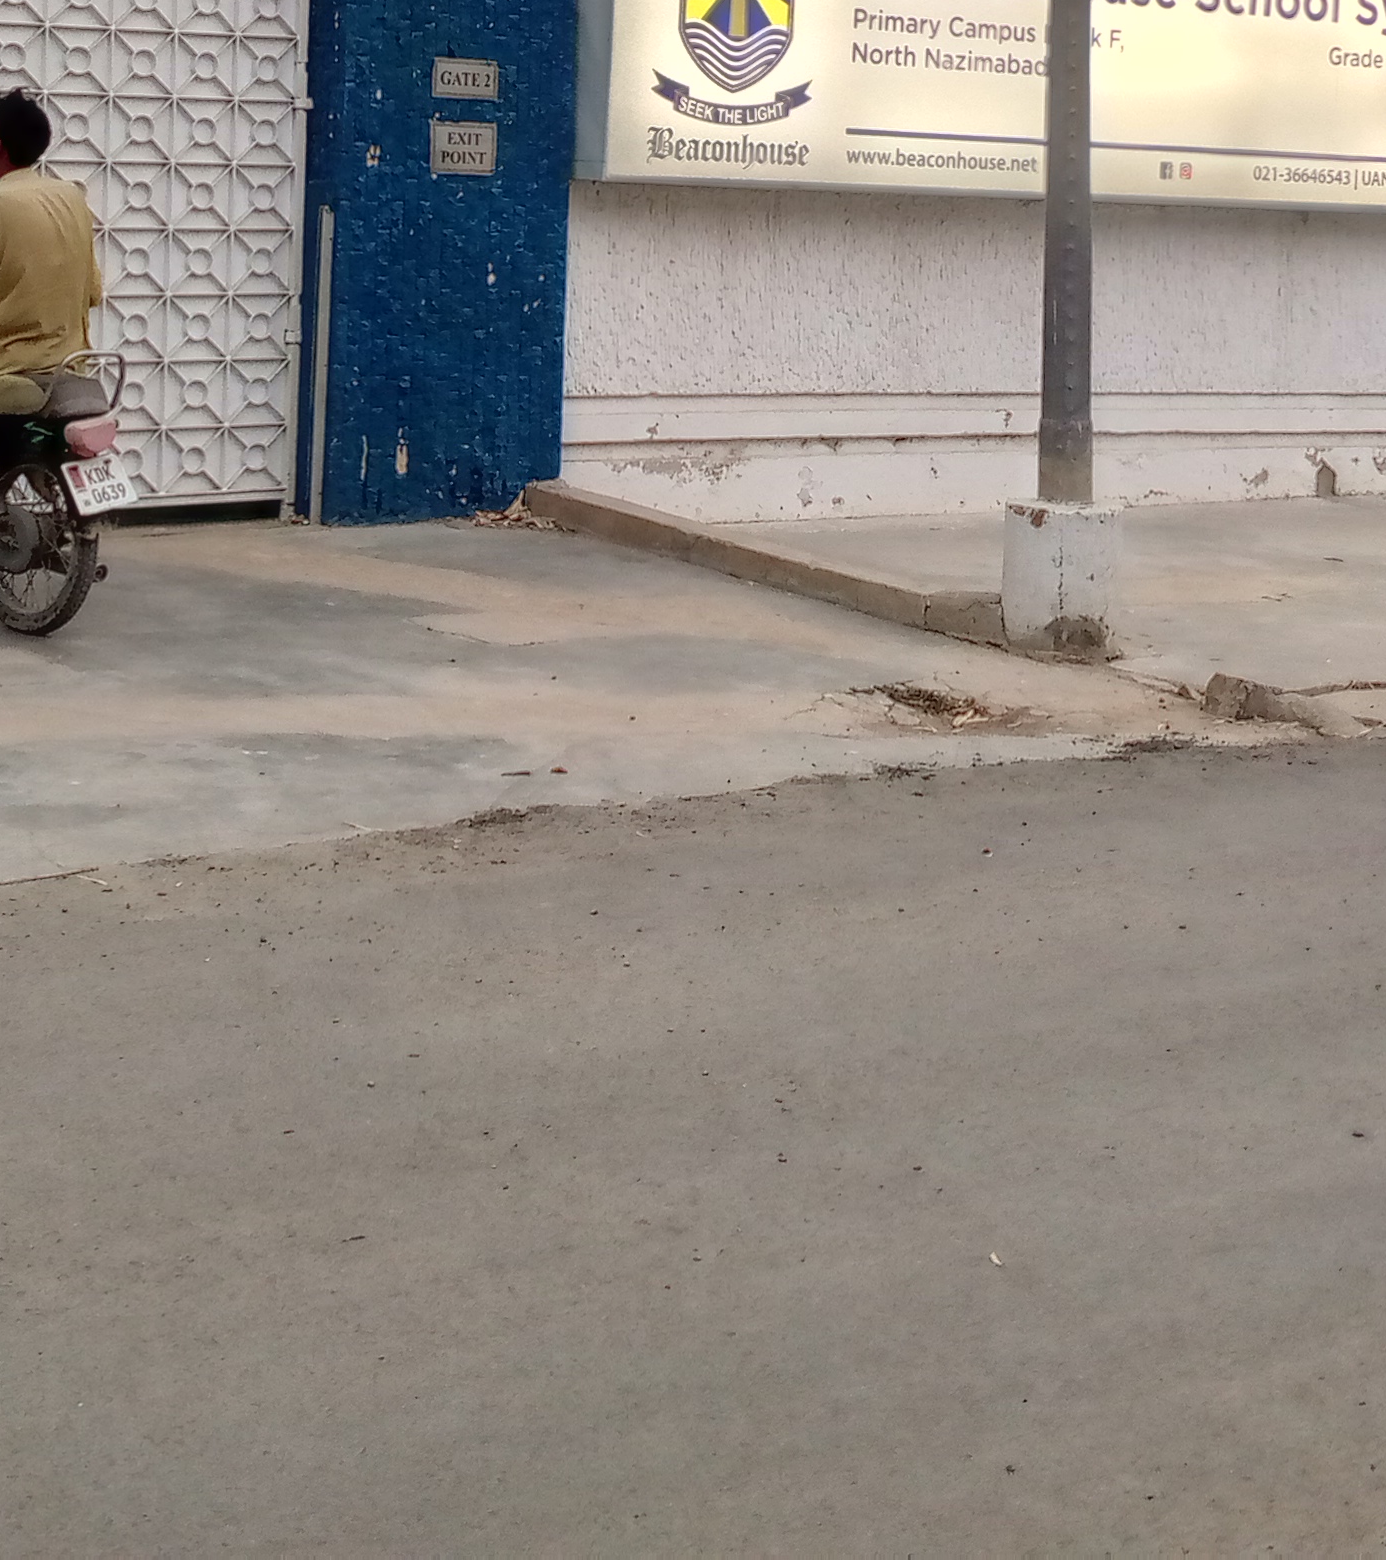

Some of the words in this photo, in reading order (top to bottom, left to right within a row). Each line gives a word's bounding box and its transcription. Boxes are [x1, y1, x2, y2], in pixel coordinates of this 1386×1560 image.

[853, 8, 941, 39] Primary
[948, 16, 1037, 44] Campus
[1109, 29, 1124, 53] F,
[851, 41, 916, 68] North
[1328, 46, 1383, 69] Grade
[439, 70, 481, 88] GATE
[484, 73, 491, 88] 2
[677, 96, 714, 121] SEEK
[717, 107, 743, 125] THE
[746, 101, 785, 123] LIGHT
[447, 131, 482, 146] EXIT
[646, 126, 811, 170] Beaconhouse
[440, 150, 487, 165] POINT
[846, 147, 1038, 173] www.beaconhouse.net
[1252, 165, 1352, 186] 021-36646543
[84, 464, 116, 485] KDK
[91, 482, 127, 504] 0639
